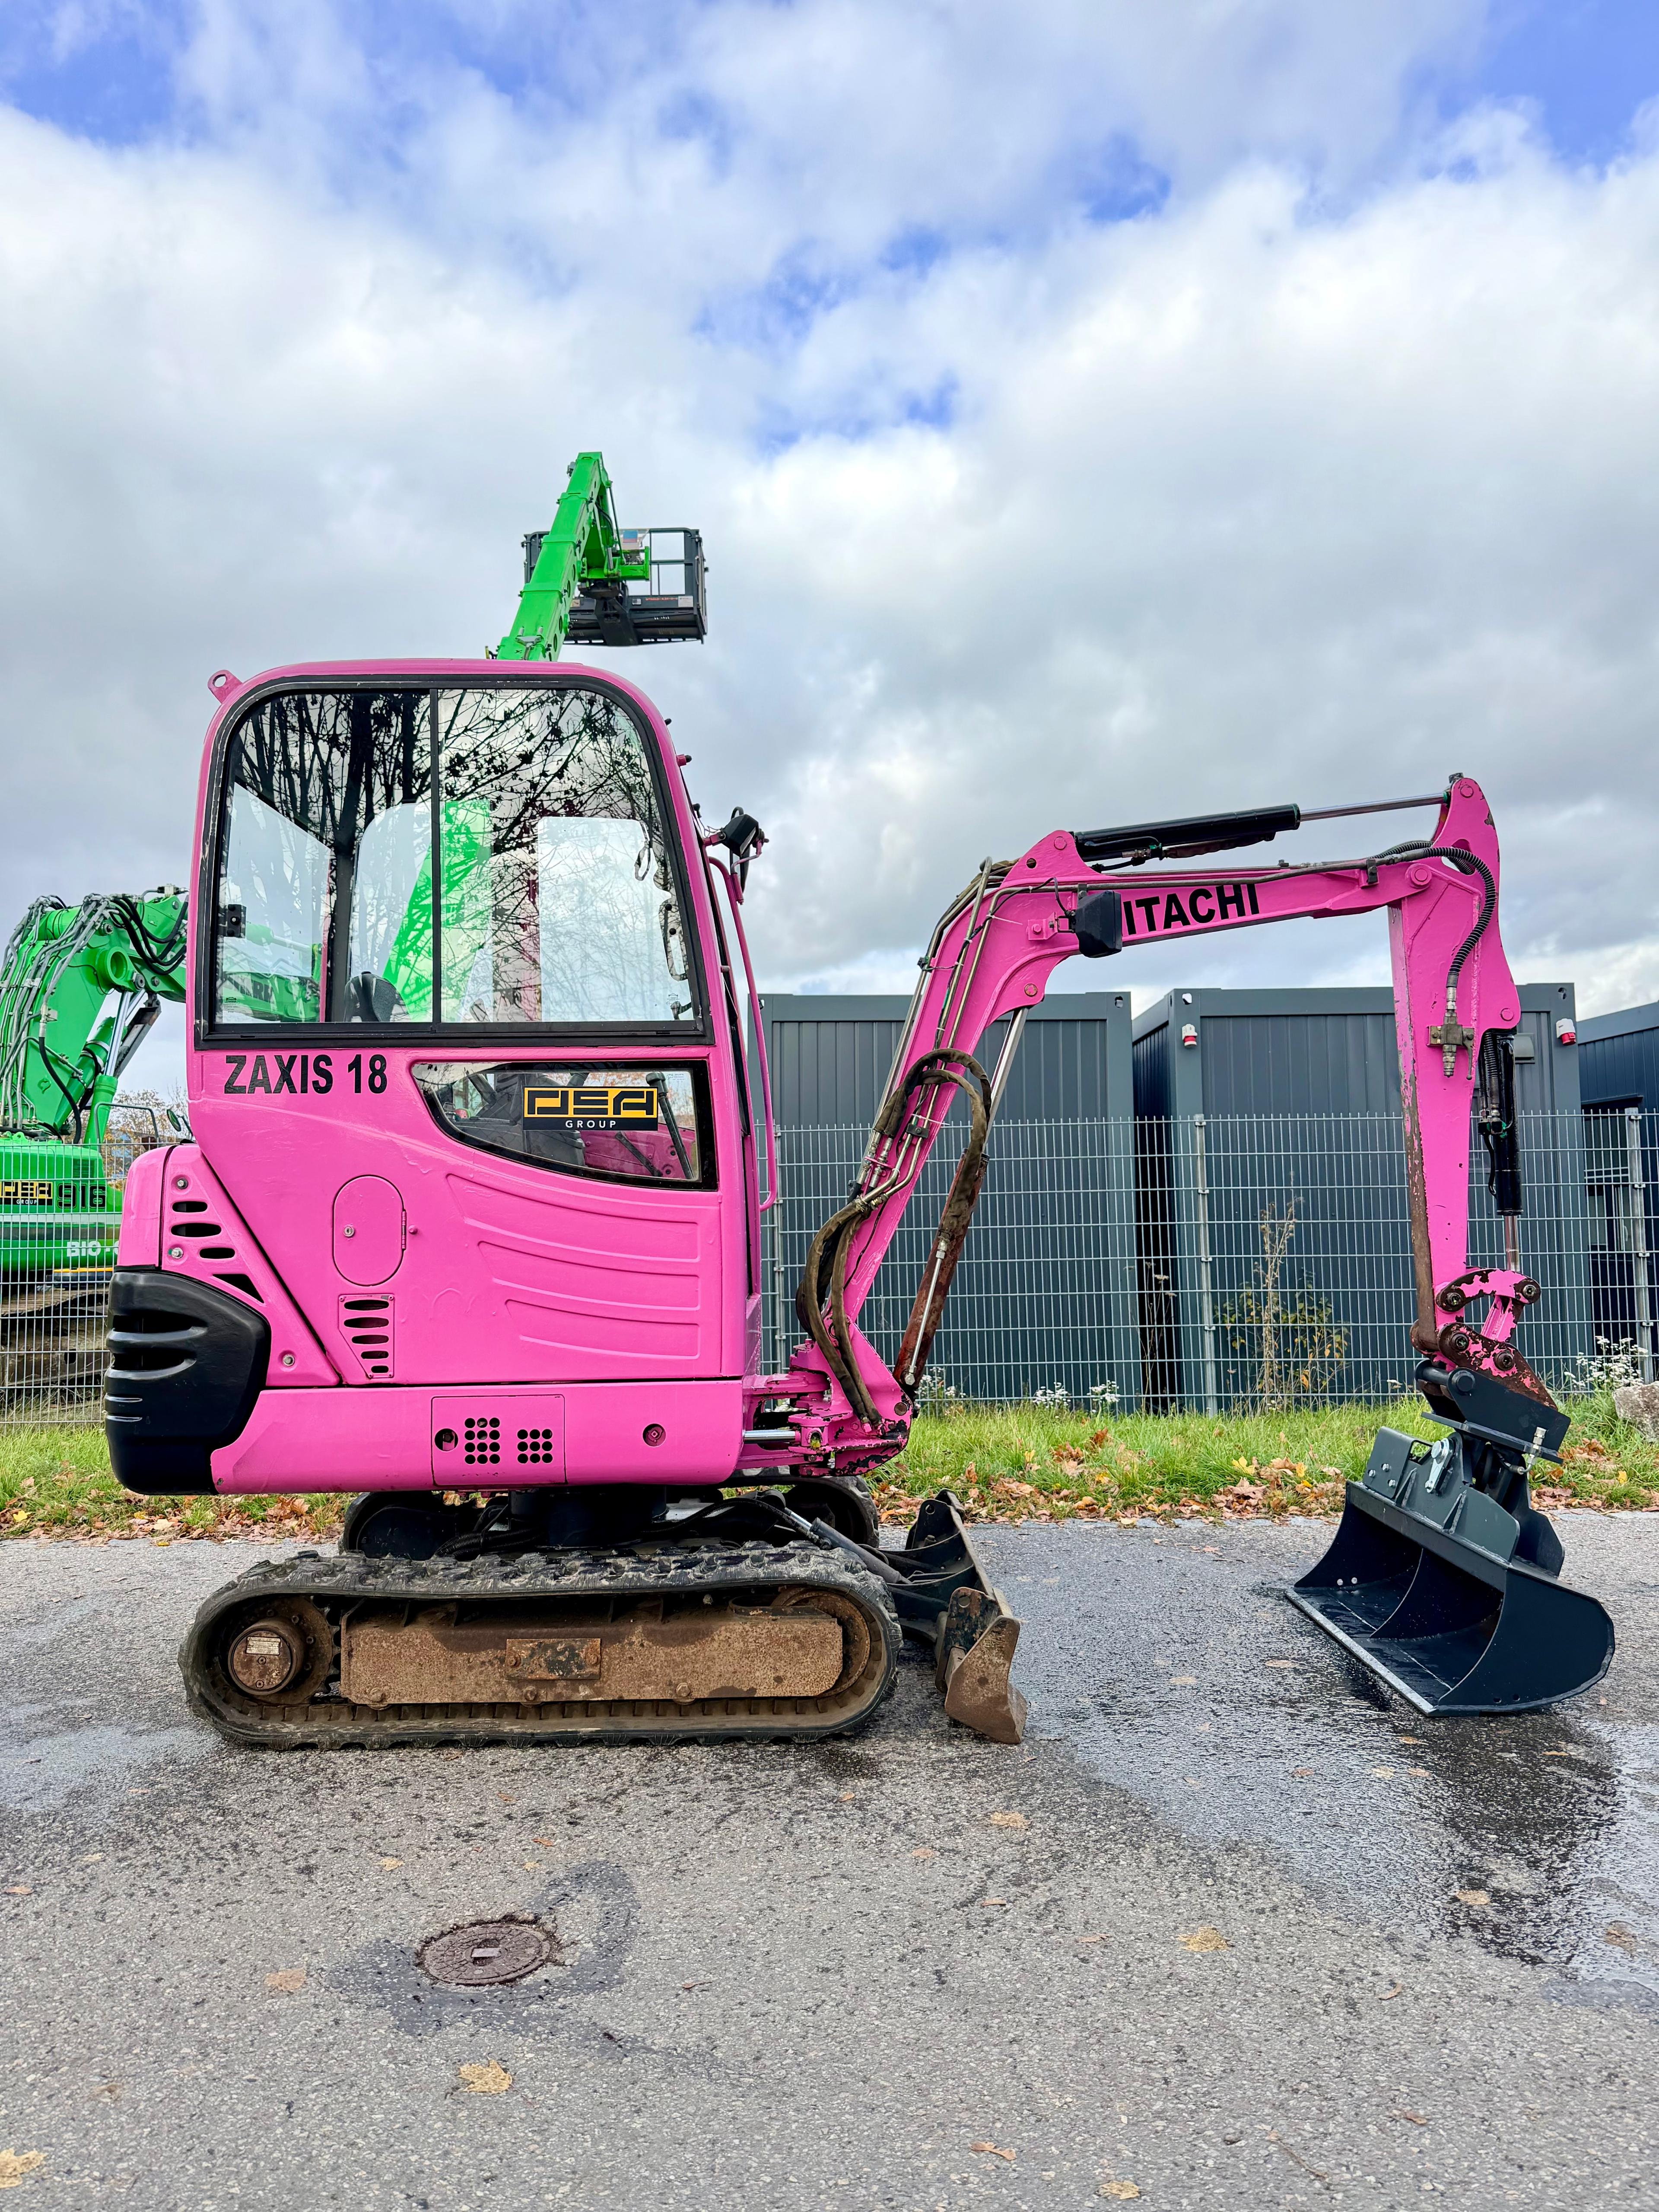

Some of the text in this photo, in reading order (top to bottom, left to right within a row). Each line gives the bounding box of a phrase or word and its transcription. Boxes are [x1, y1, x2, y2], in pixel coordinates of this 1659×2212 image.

[1123, 884, 1260, 935] ITACHI
[224, 1054, 388, 1094] ZAXIS 18
[566, 1120, 617, 1128] GROUP
[57, 1183, 106, 1209] 916
